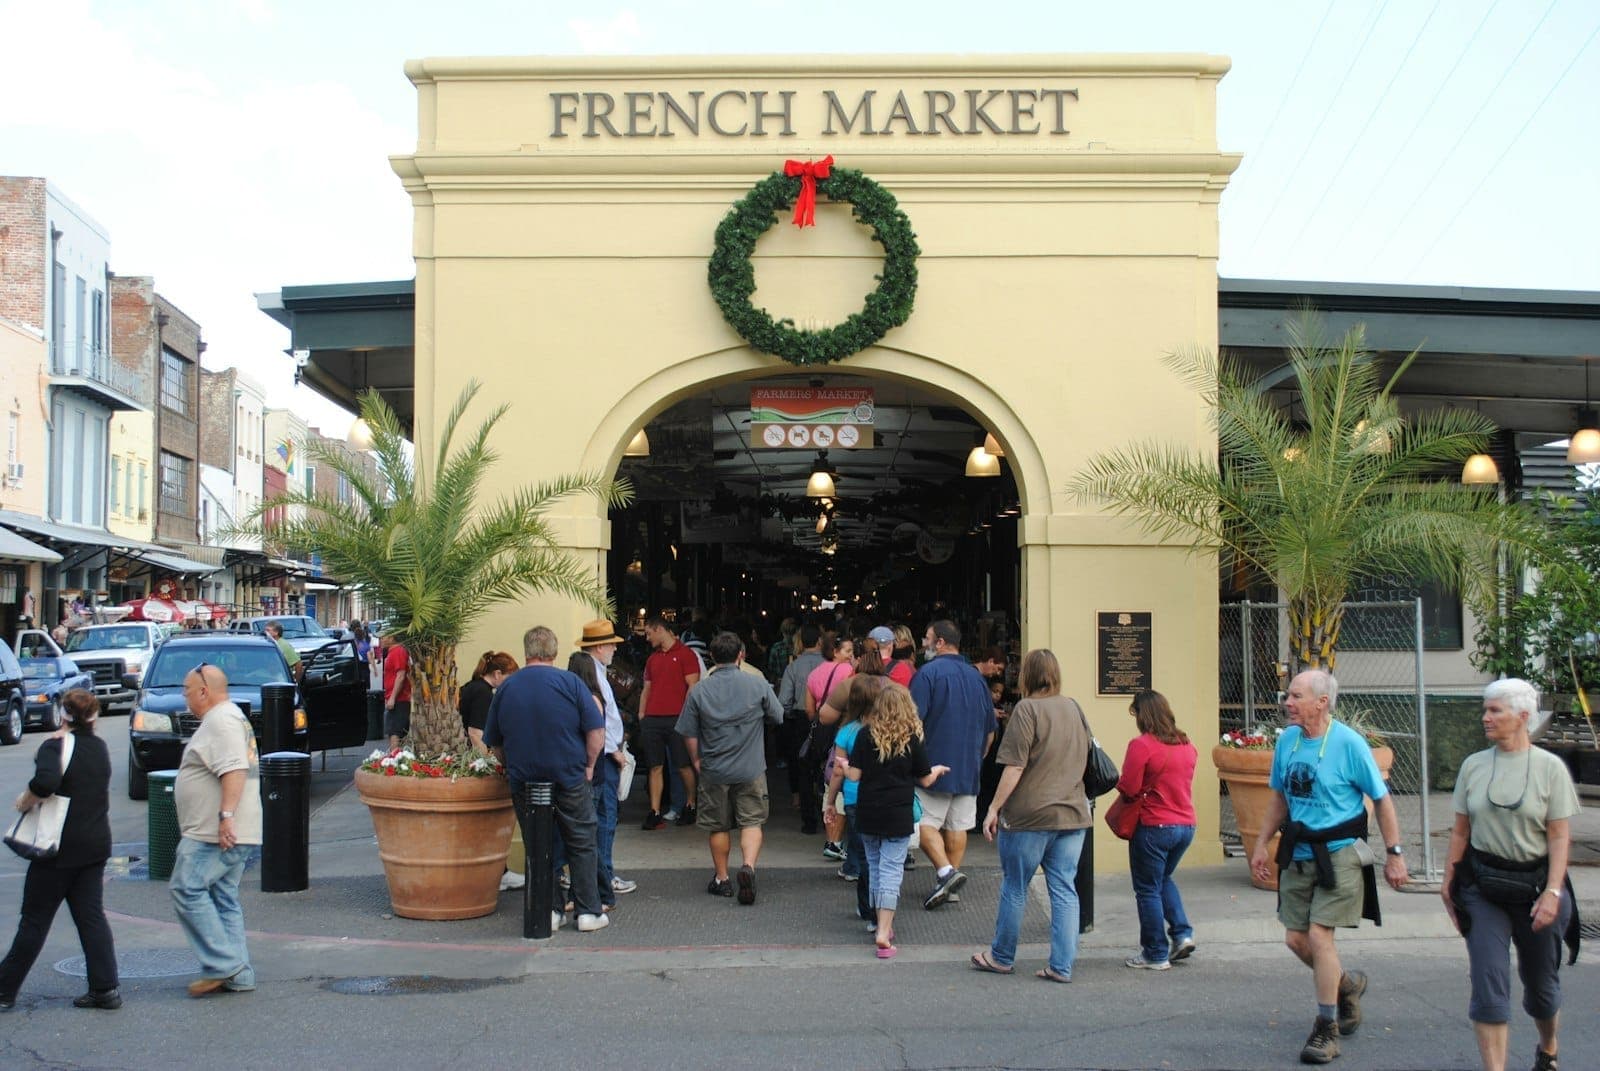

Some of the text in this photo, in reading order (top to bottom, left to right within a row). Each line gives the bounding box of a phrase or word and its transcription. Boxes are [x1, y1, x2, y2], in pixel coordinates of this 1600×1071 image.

[549, 89, 1078, 138] FRENCH MARKET
[817, 389, 867, 400] MARKET
